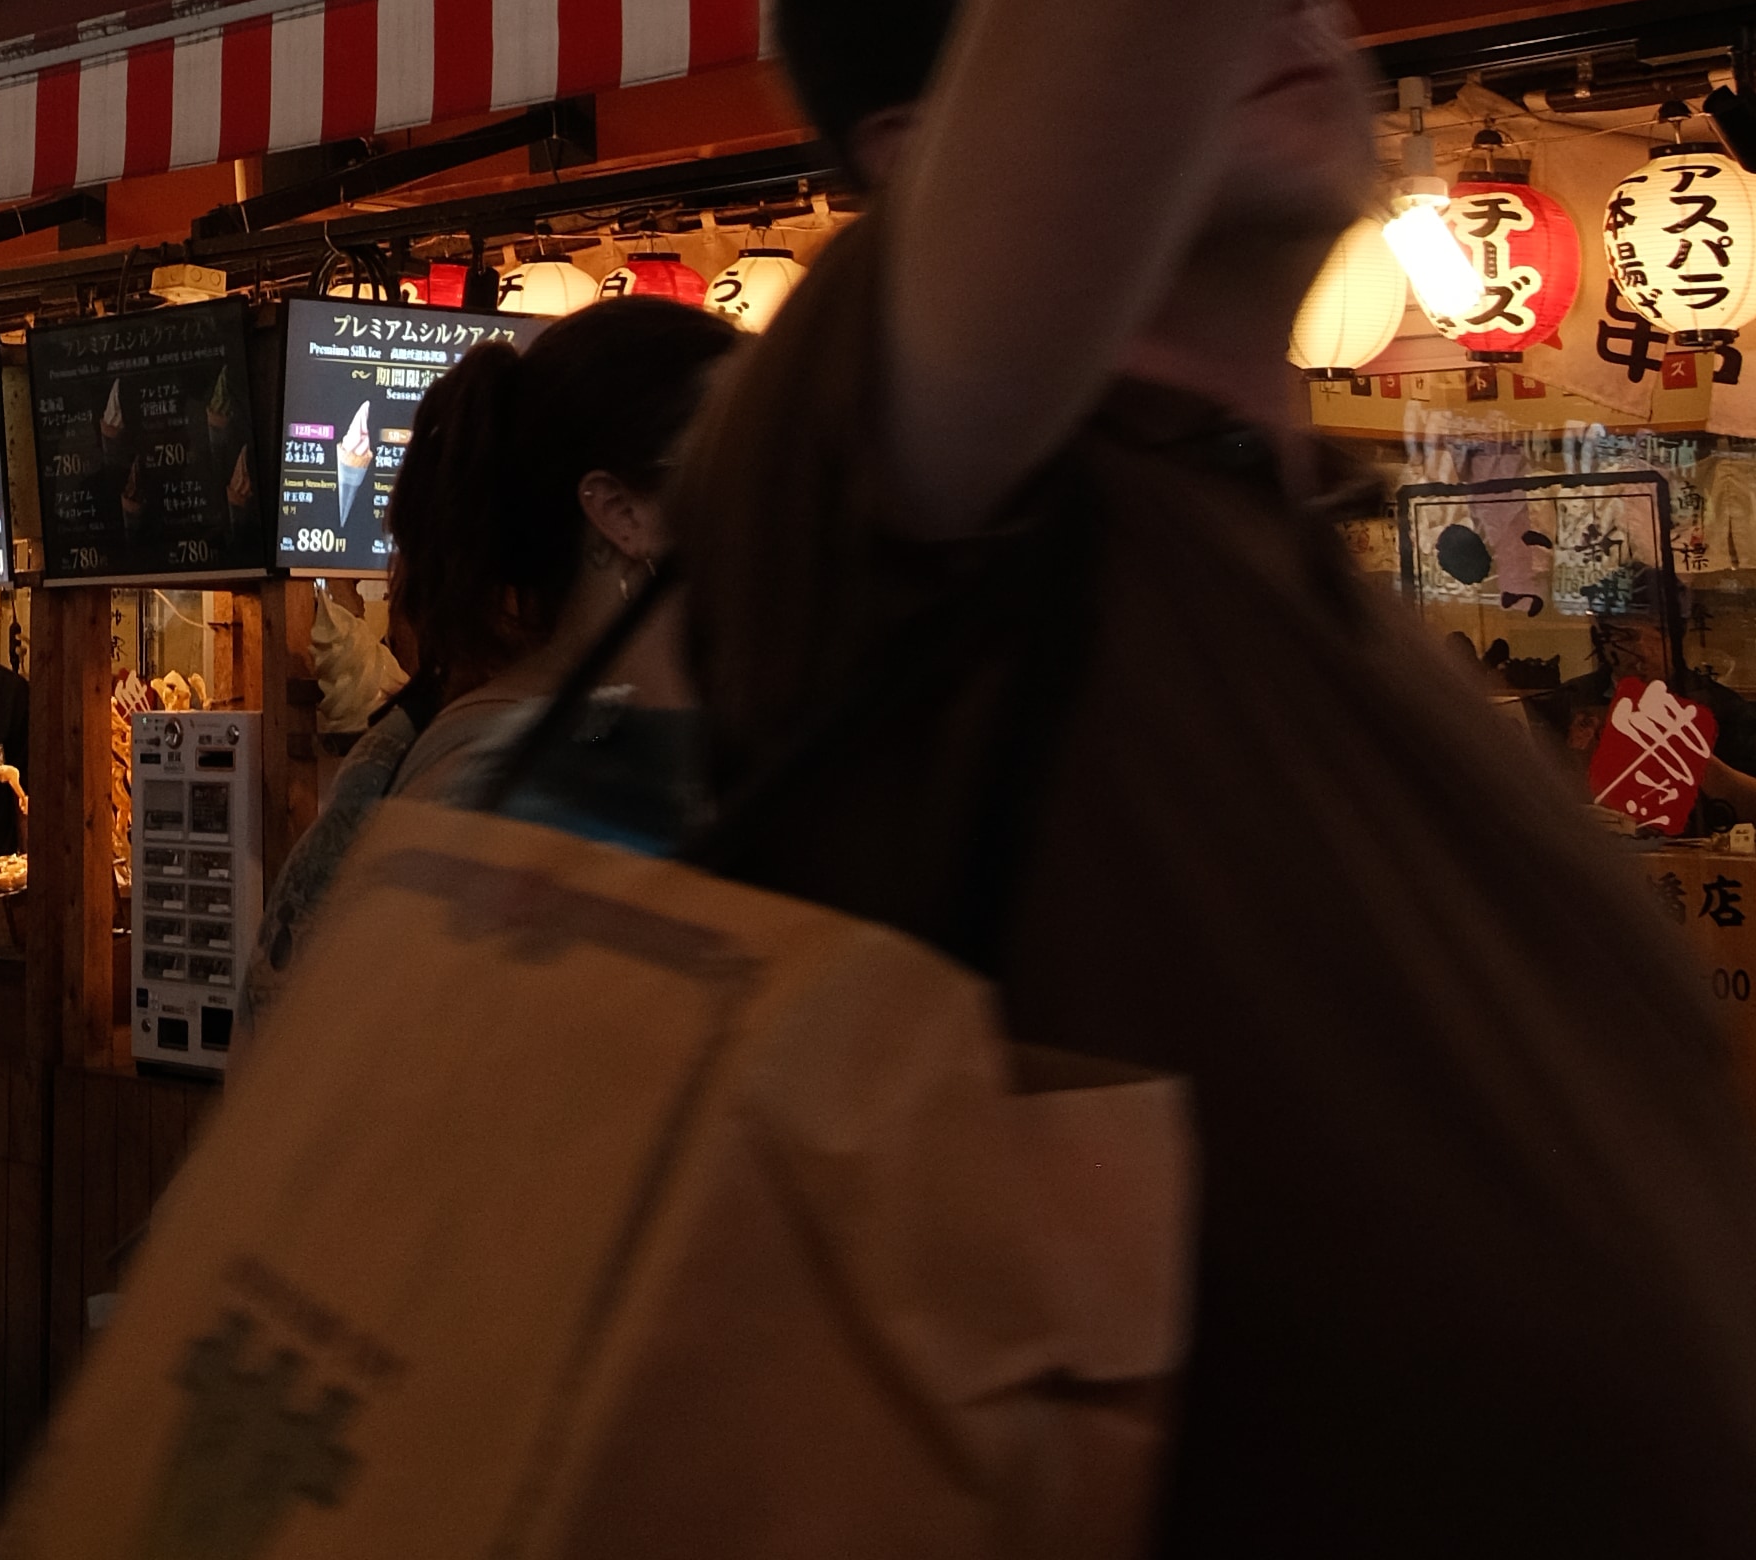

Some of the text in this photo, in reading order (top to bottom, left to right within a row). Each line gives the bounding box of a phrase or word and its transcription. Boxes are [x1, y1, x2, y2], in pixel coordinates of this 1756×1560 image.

[1461, 198, 1531, 327] チーズ
[1660, 165, 1734, 310] アスパラ
[309, 342, 349, 358] Premium
[351, 344, 367, 359] Silk
[368, 346, 382, 360] Ice
[296, 528, 347, 553] 880円
